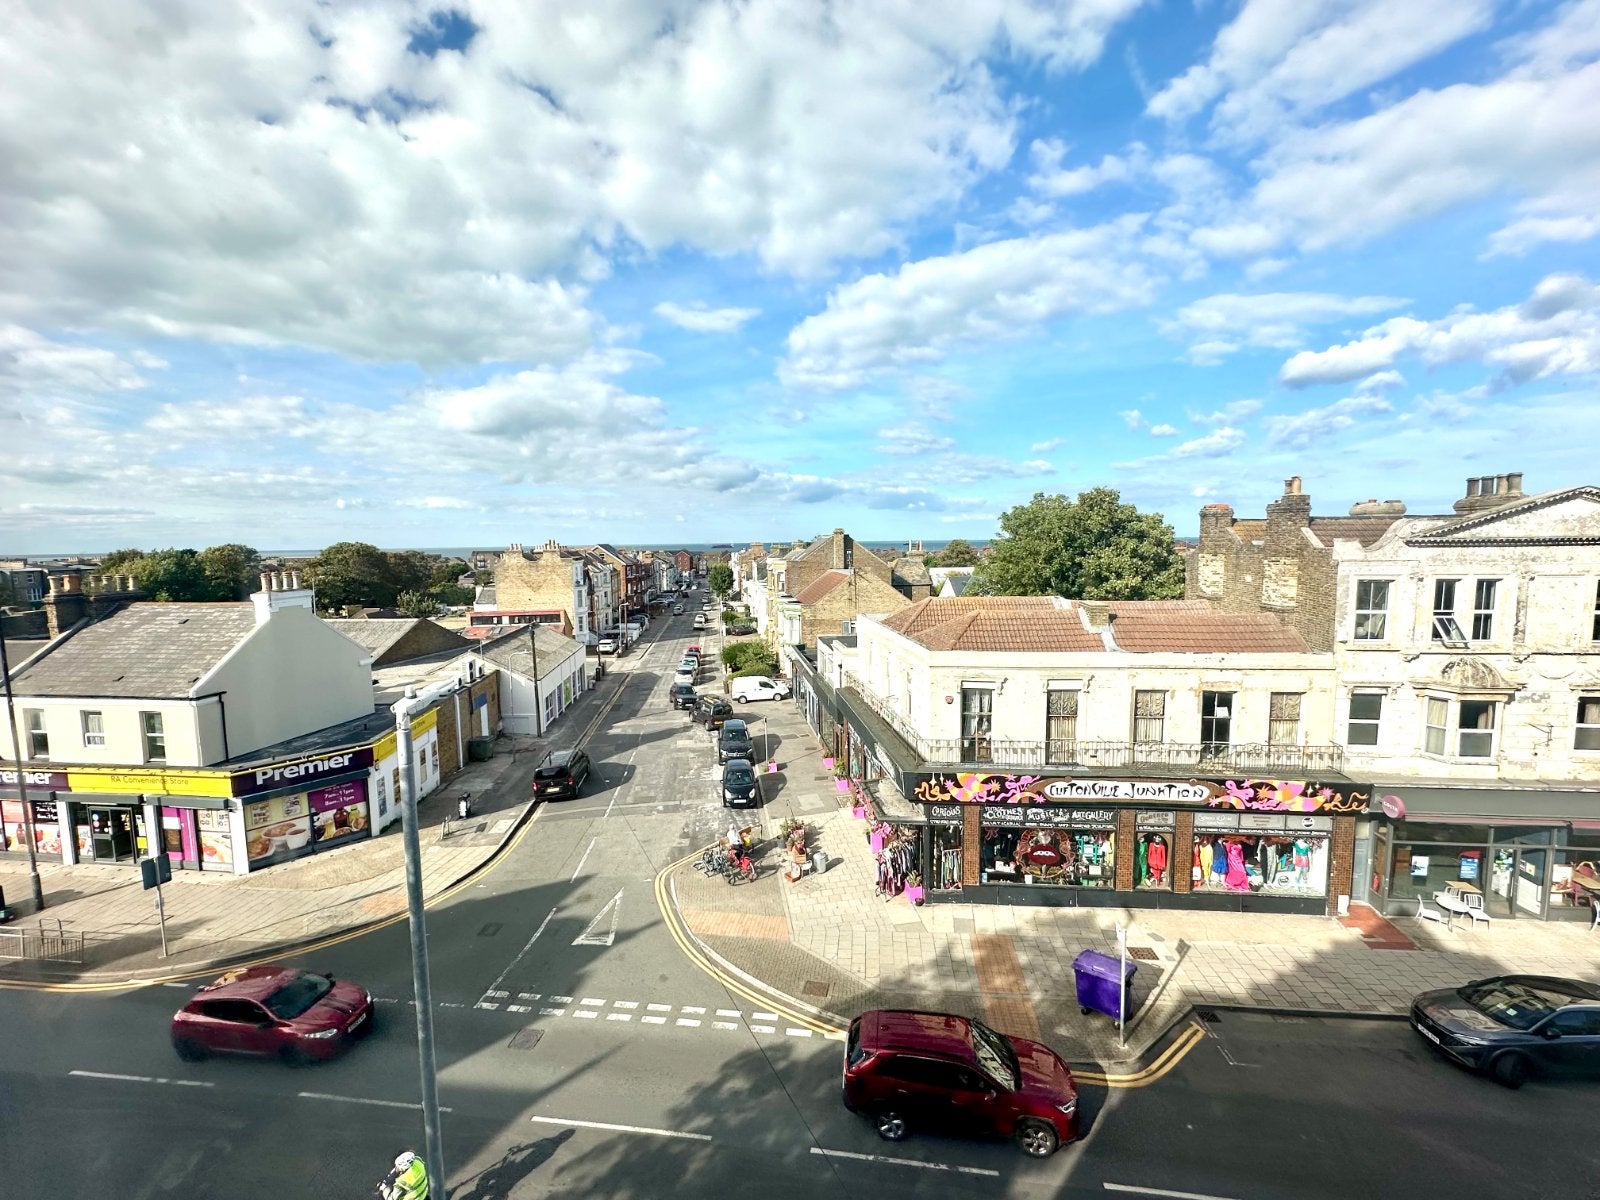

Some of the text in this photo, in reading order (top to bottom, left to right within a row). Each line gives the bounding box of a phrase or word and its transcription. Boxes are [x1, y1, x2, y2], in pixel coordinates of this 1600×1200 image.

[255, 753, 353, 786] Premier
[110, 775, 189, 785] RA Convenience Store
[986, 806, 1023, 820] CLOTHES
[1027, 809, 1055, 821] MUSIC
